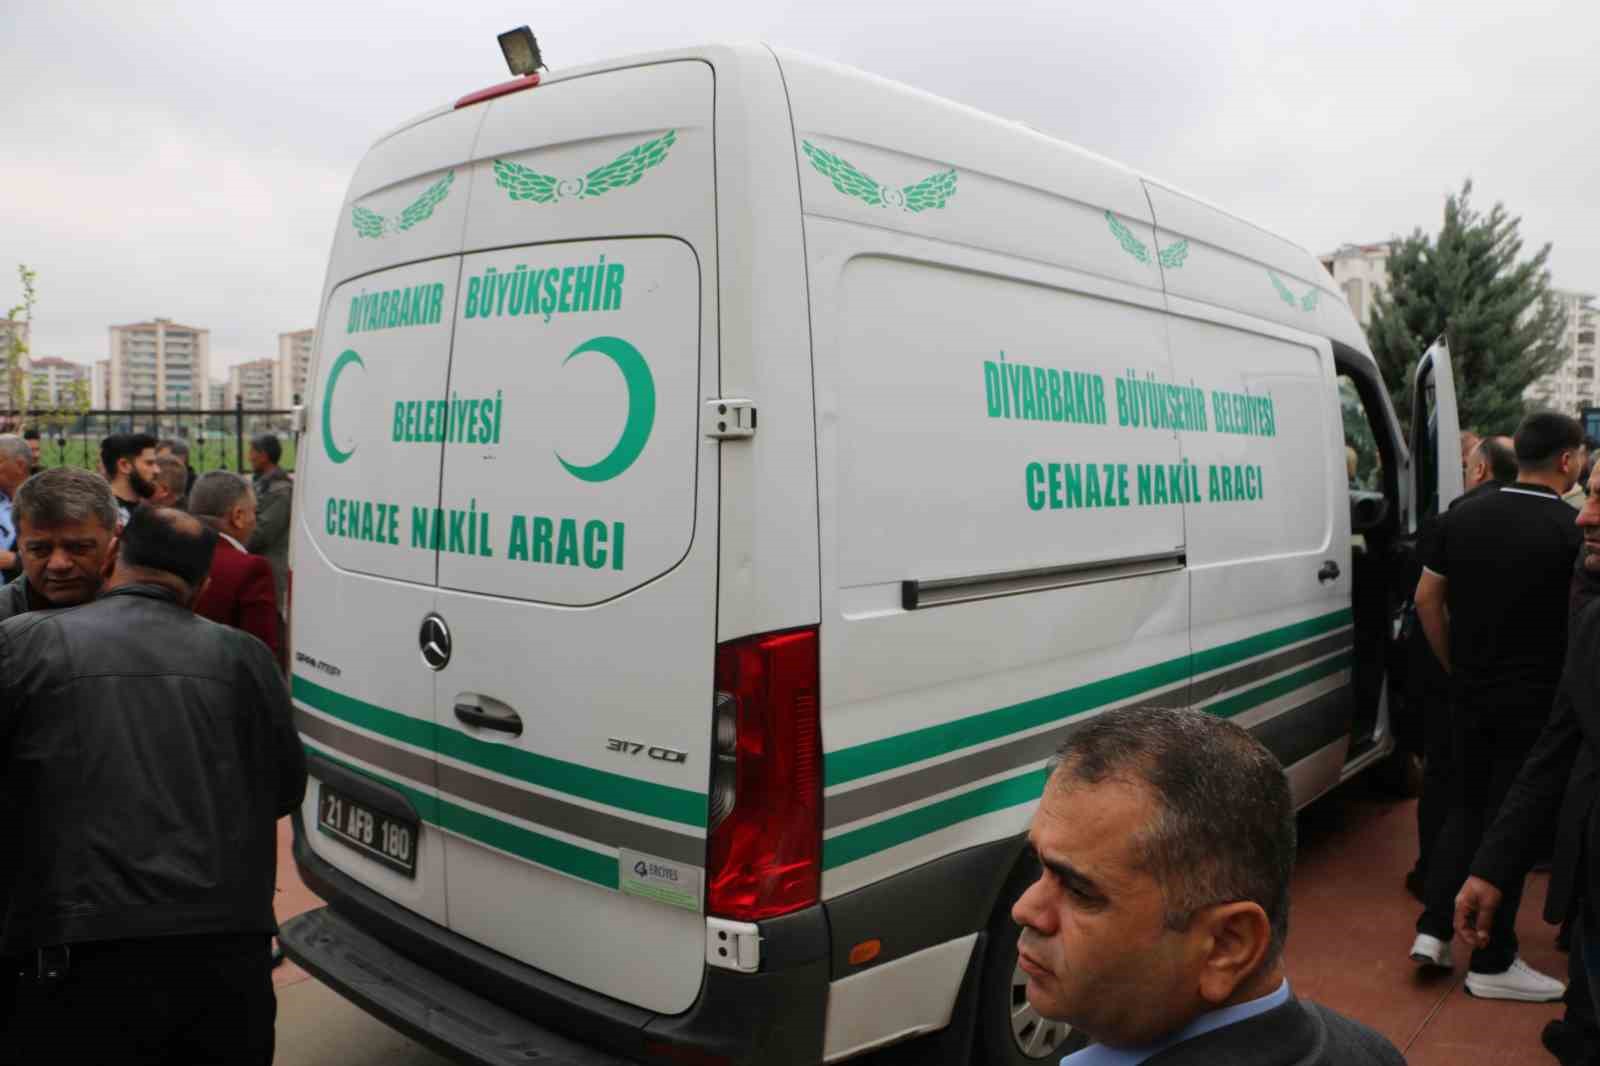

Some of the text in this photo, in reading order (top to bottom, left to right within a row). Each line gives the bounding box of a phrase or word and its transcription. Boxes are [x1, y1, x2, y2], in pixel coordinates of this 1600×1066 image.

[347, 253, 625, 334] DİYARBAKIR BÜYÜKŞEHİR
[391, 389, 503, 444] BELEDİYESİ
[984, 350, 1276, 440] DİYARBAKIR BÜYÜKŞEHİR BELEDİYESİ
[1025, 457, 1263, 511] CENAZE NAKİL ARACI
[325, 497, 625, 571] CENAZE NAKİL ARACI
[606, 738, 645, 756] 317
[326, 794, 410, 861] 21 AFB 180
